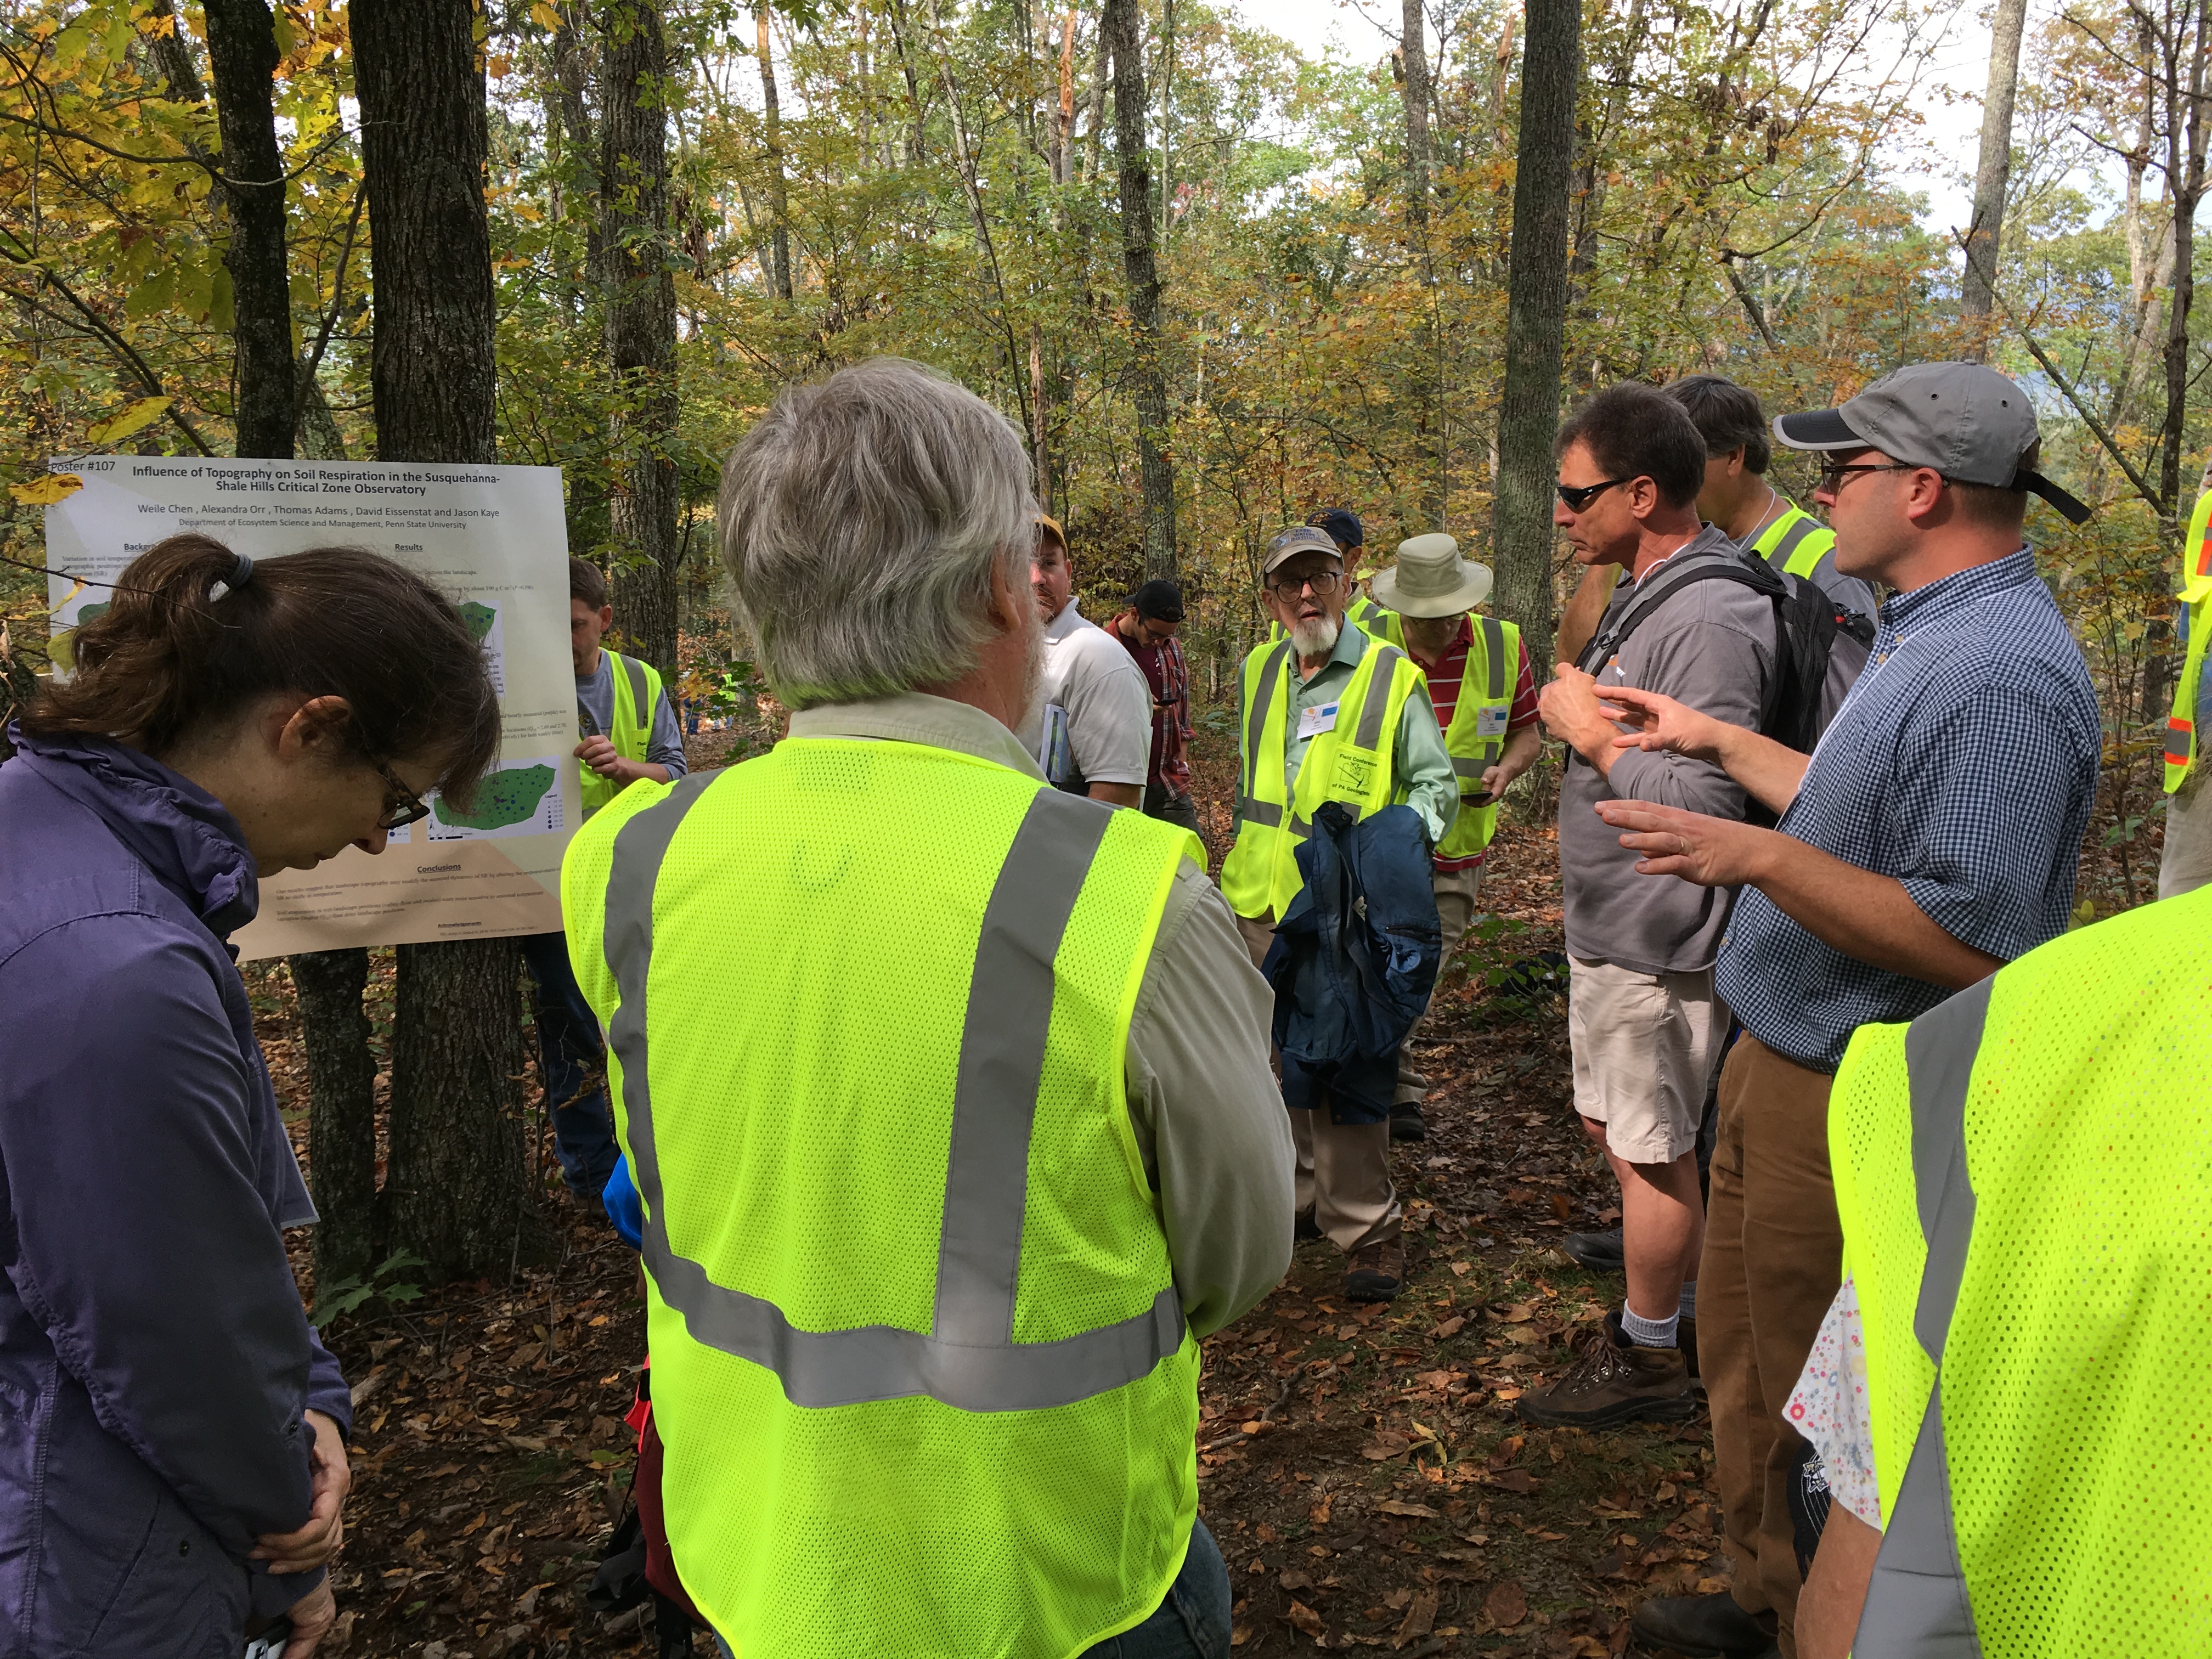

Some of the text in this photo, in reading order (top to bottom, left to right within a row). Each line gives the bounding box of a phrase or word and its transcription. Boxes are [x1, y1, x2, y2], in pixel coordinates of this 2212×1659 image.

[51, 461, 116, 472] Poster #107
[133, 466, 500, 484] Influence of Topography on Soil Respiration in the Susquehanna-
[216, 481, 426, 496] Shale Hills Critical Zone Observatory
[137, 504, 166, 514] Weile
[168, 504, 193, 514] Chen
[201, 505, 248, 514] Alexandra
[250, 505, 266, 514] Orr
[274, 505, 313, 515] Thomas
[314, 506, 348, 515] Adams
[356, 507, 382, 516] David
[385, 507, 432, 516] Eissenstat
[435, 508, 452, 517] and
[454, 509, 479, 517] Jason
[481, 509, 499, 518] Kaye
[179, 518, 226, 528] Department
[238, 520, 278, 528] Ecosystem
[329, 520, 383, 529] Management,
[428, 521, 467, 529] University
[1353, 757, 1378, 767] Conference
[1347, 787, 1370, 796] Geologists
[417, 864, 461, 873] Conclusions
